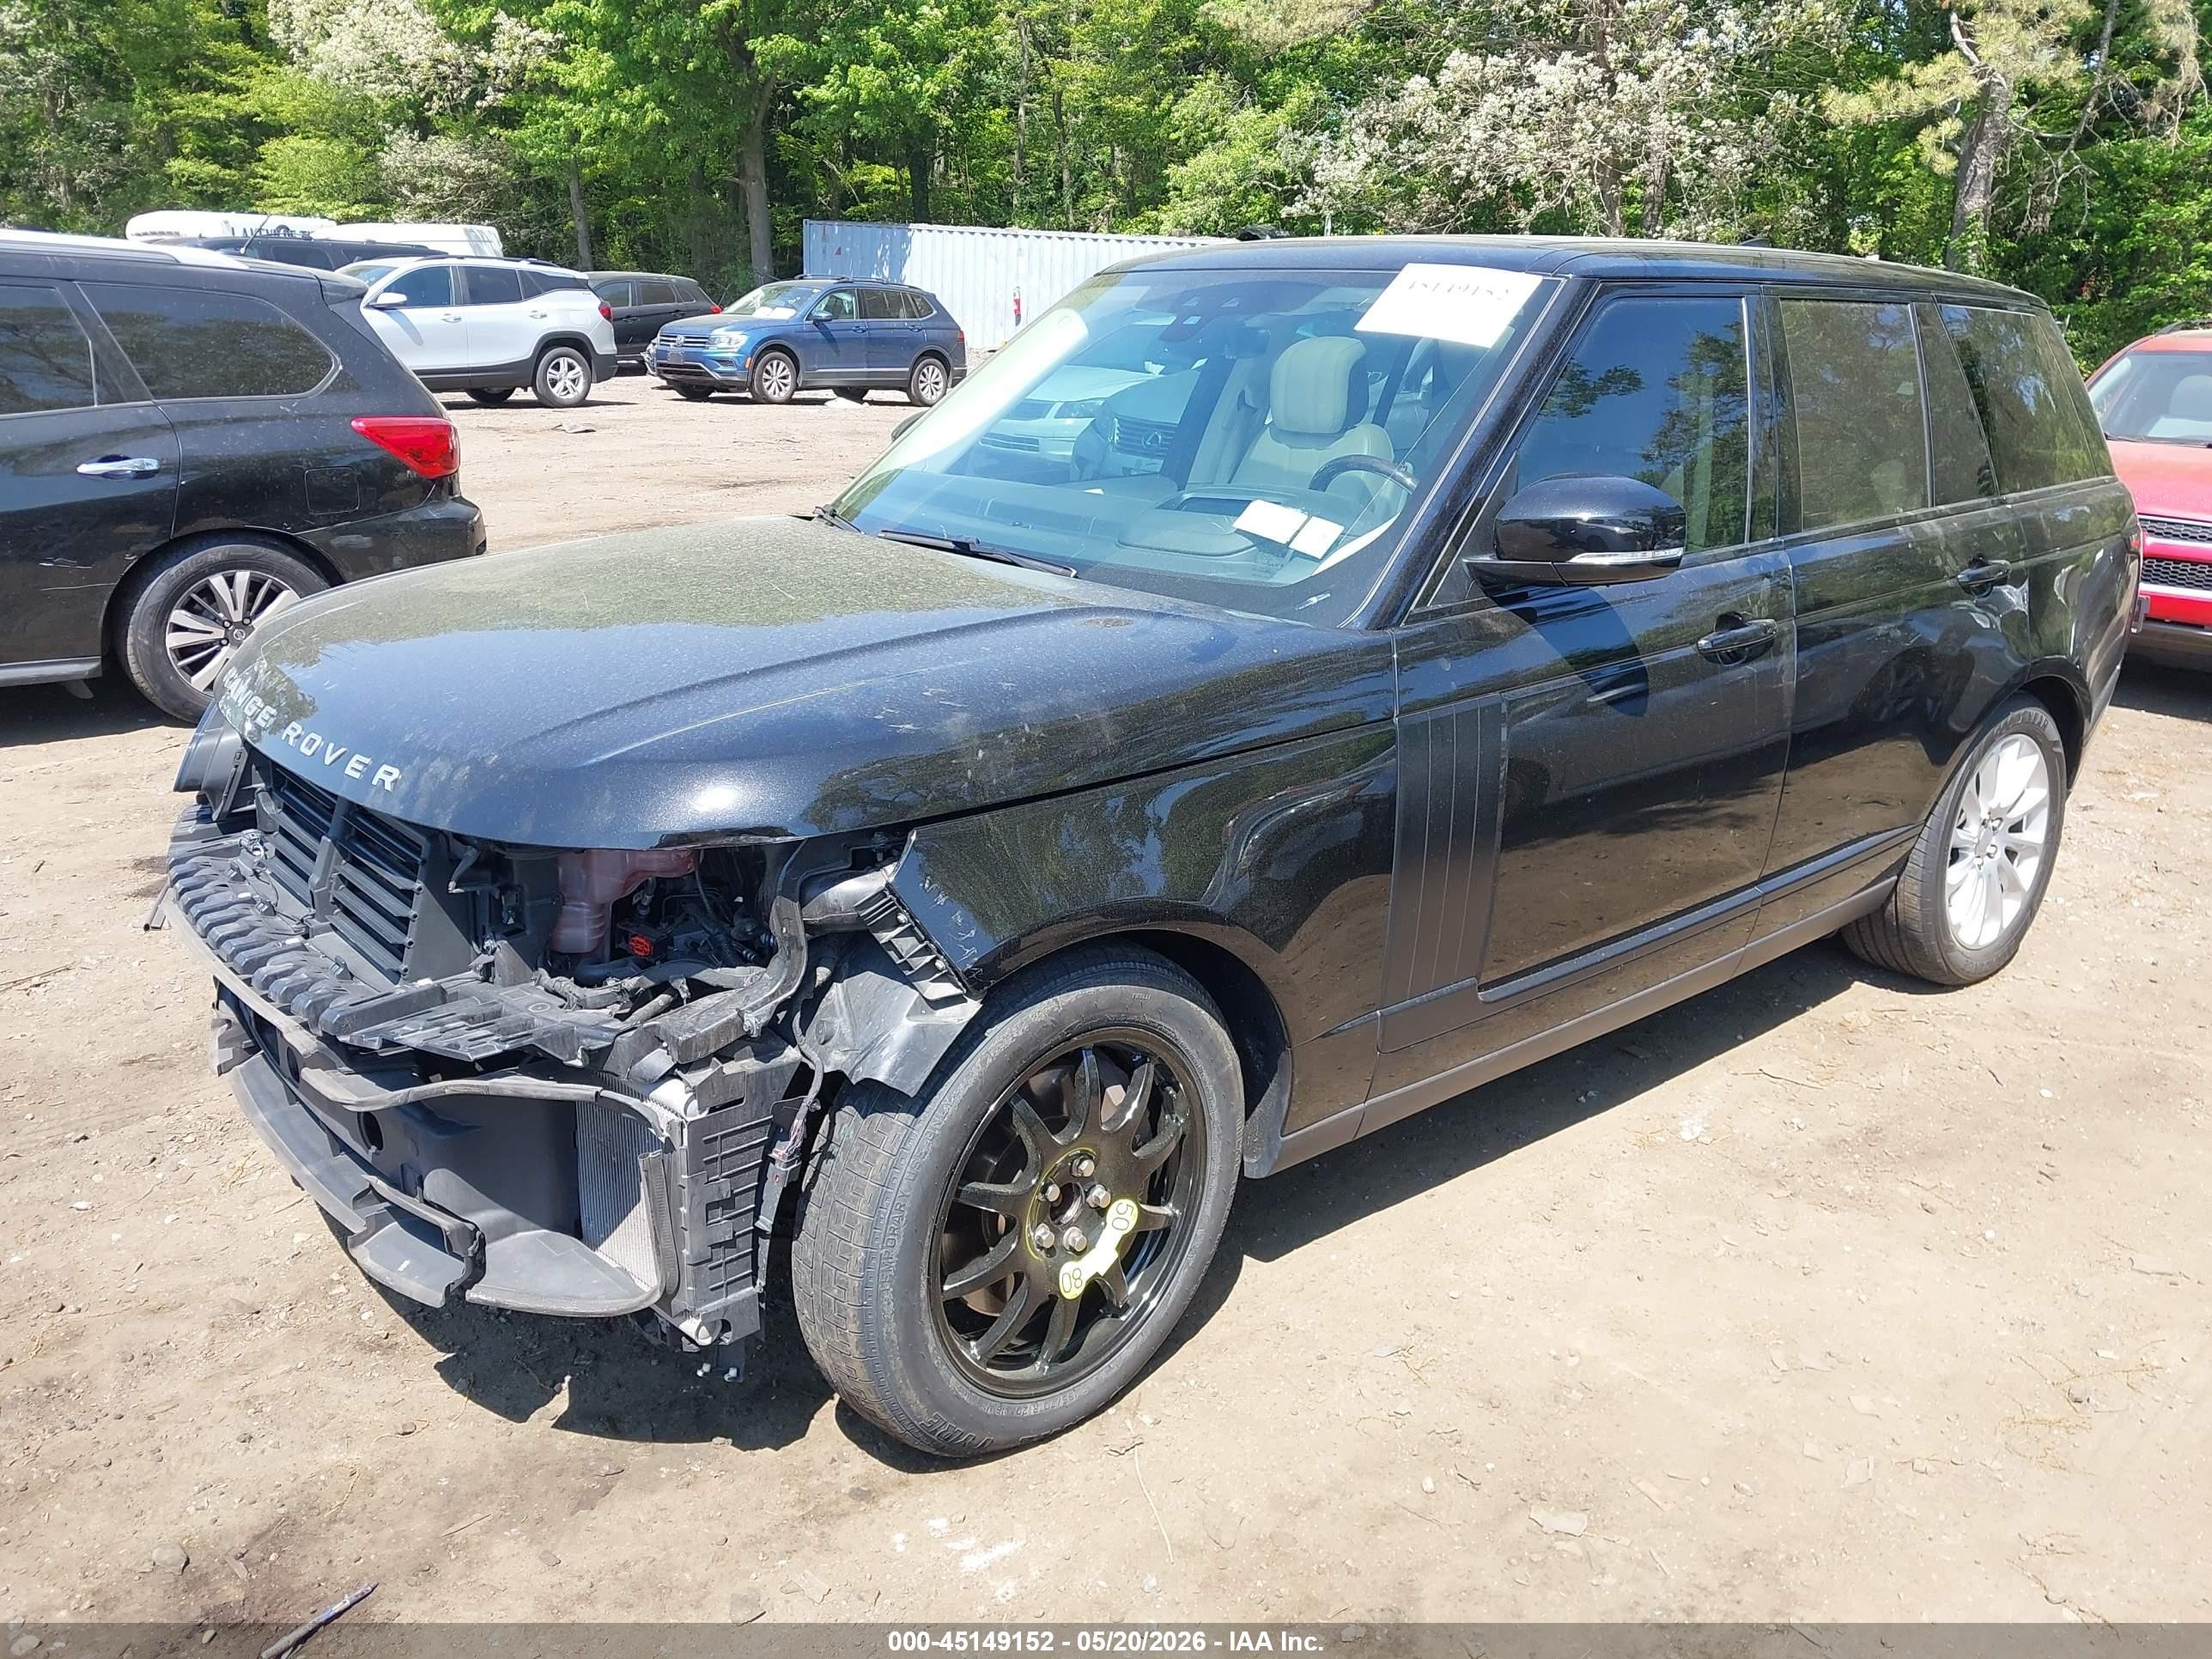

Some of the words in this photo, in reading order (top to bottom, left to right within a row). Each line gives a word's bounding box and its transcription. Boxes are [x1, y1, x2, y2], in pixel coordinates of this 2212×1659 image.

[223, 668, 277, 730] RANGE
[281, 720, 401, 793] ROVER
[1111, 1202, 1134, 1231] 50
[1060, 1267, 1083, 1293] 80
